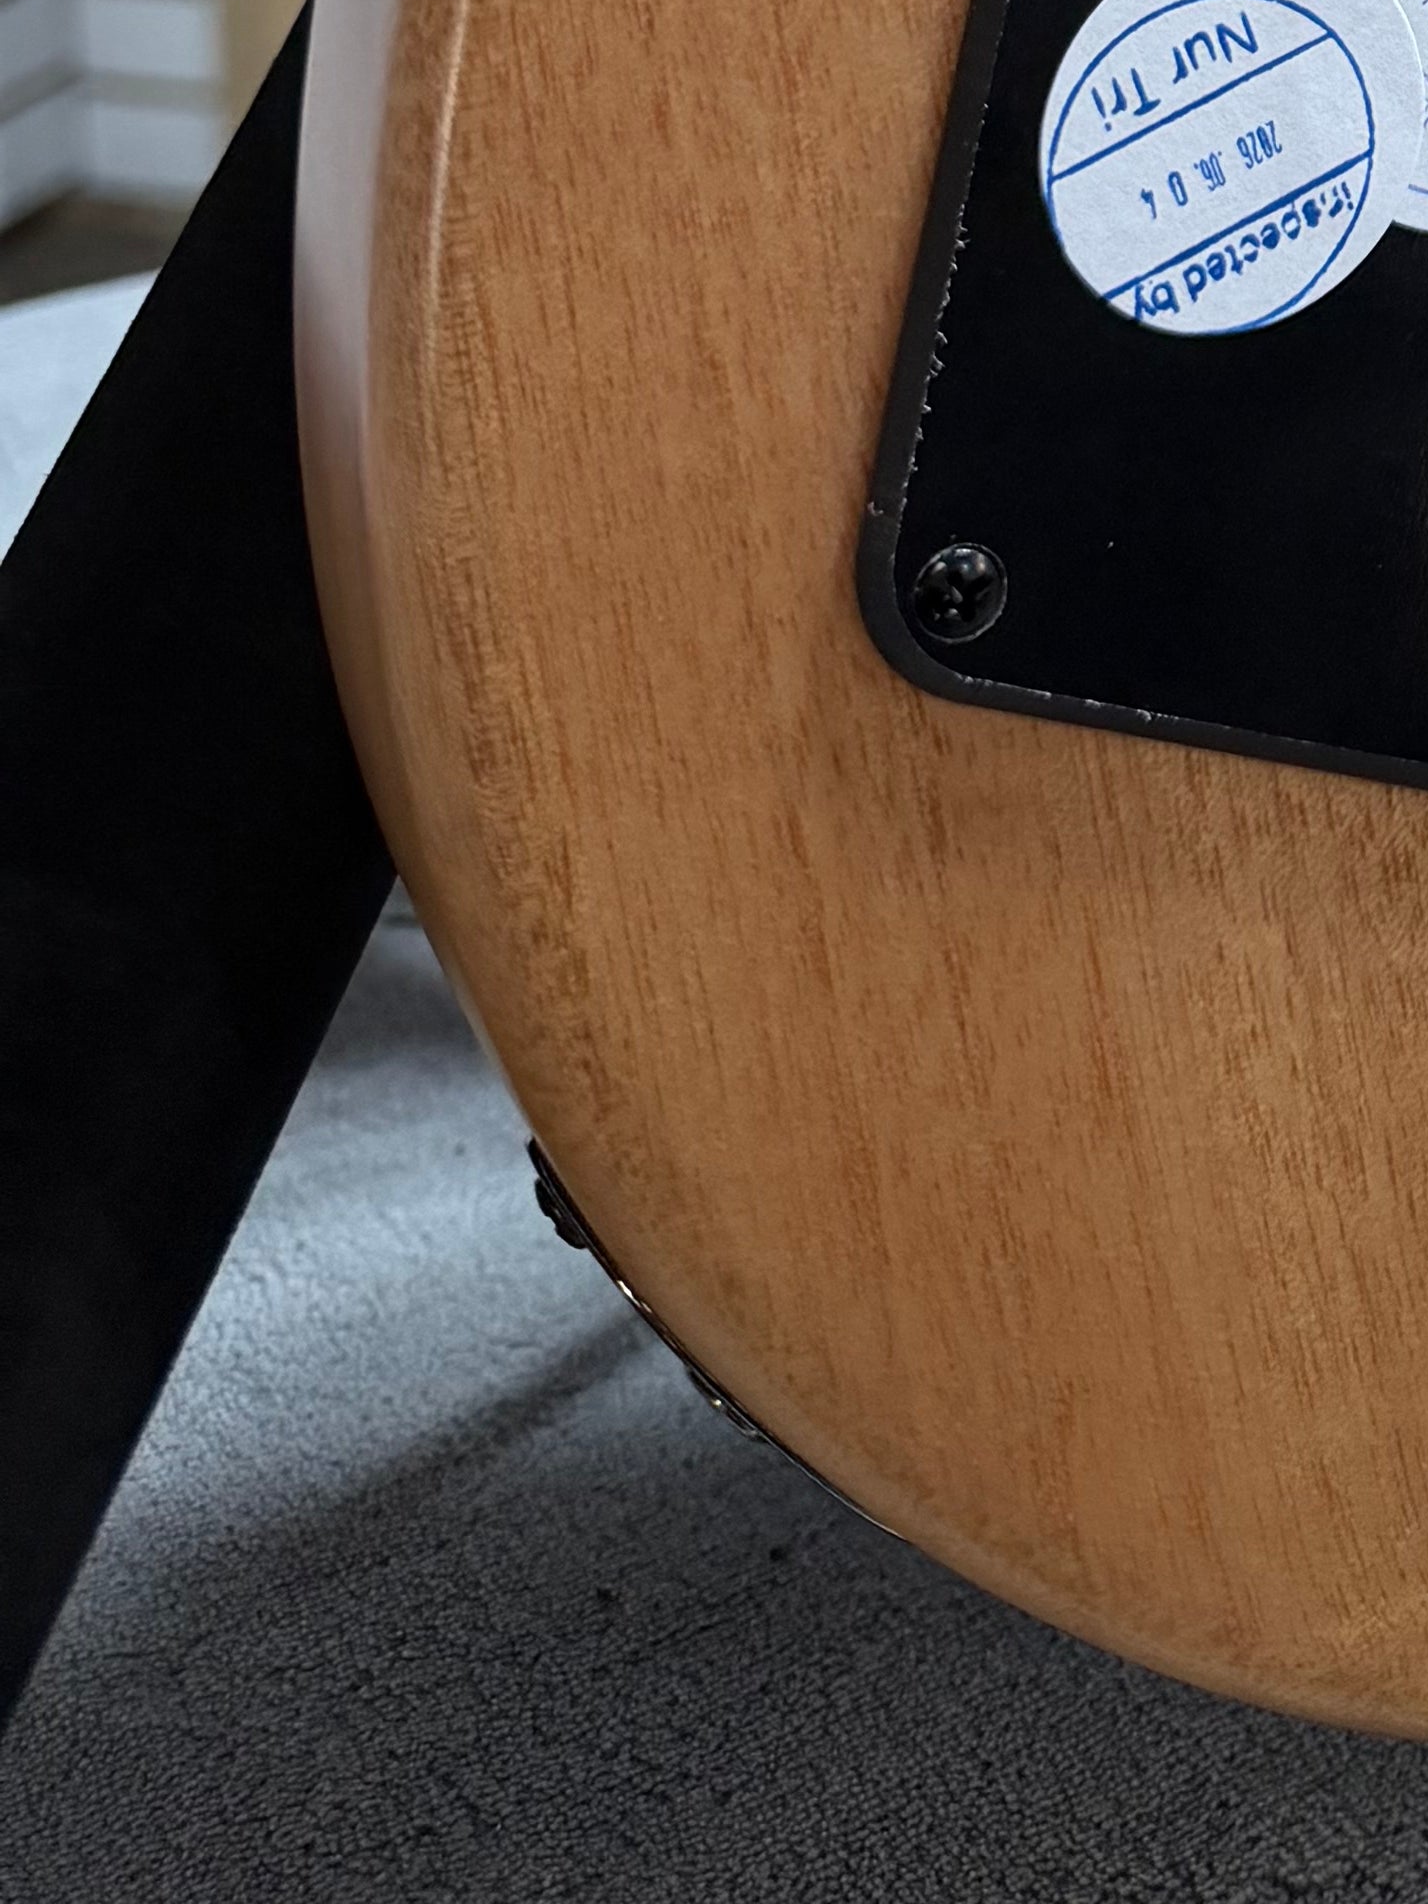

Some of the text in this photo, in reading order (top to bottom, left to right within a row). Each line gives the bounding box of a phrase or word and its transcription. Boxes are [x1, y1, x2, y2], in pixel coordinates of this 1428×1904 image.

[1091, 12, 1259, 132] Nur Tri
[1132, 279, 1180, 322] by
